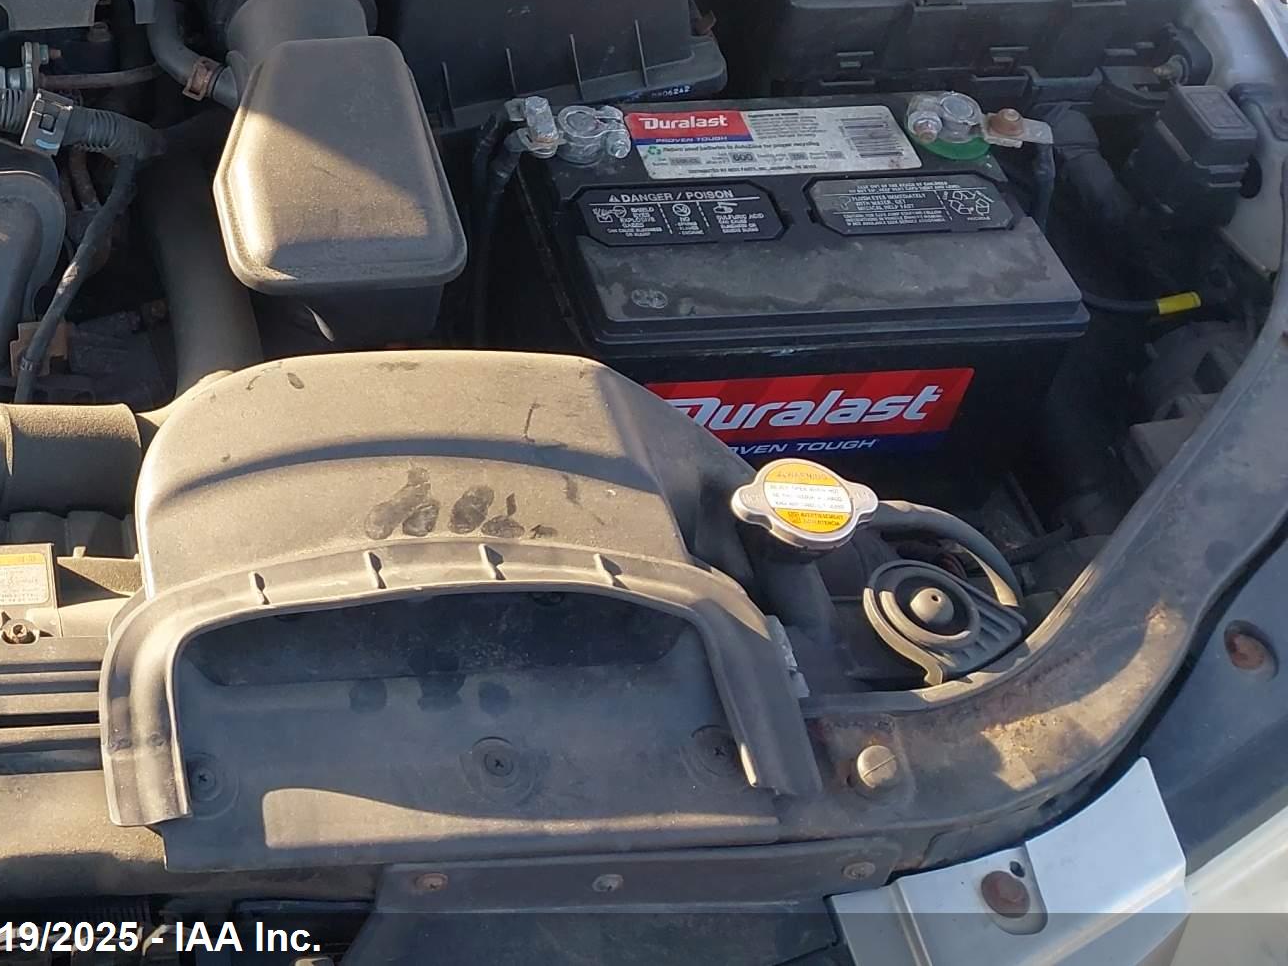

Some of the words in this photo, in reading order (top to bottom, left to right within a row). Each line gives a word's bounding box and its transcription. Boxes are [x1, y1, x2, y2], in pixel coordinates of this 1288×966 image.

[638, 114, 729, 130] Duralast
[655, 136, 694, 144] PROVEN
[696, 135, 728, 143] TOUGH
[620, 192, 674, 203] DANGER
[685, 189, 734, 201] POISON
[662, 385, 942, 431] Duralast
[797, 438, 877, 452] TOUGH
